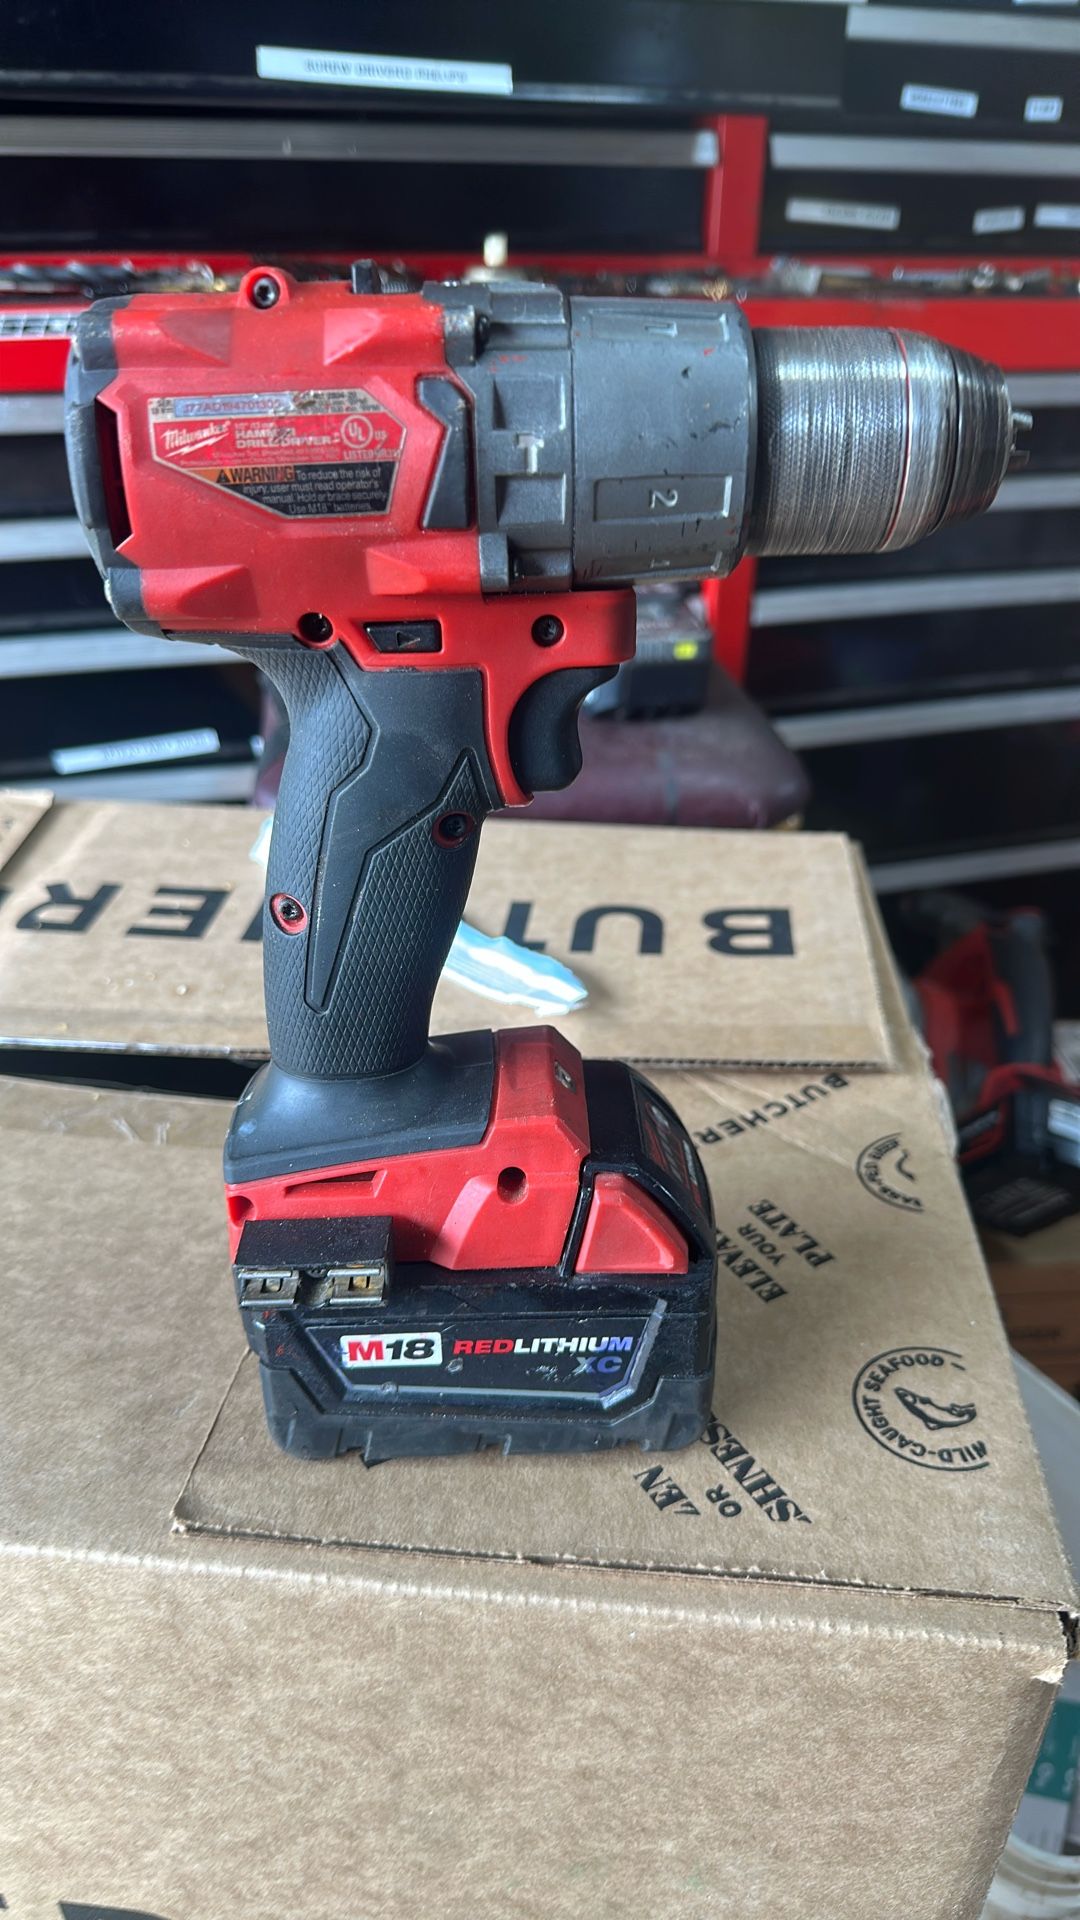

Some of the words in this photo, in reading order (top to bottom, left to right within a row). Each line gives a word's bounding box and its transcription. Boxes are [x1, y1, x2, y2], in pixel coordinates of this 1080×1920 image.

[160, 422, 229, 451] Milwaukee
[235, 428, 295, 439] HAMMR
[230, 466, 294, 483] WARNING
[308, 469, 338, 480] reduce
[339, 469, 354, 479] the
[355, 468, 371, 478] risk
[372, 467, 382, 477] of
[271, 485, 290, 493] user
[291, 482, 313, 492] must
[315, 480, 334, 491] read
[298, 492, 317, 502] Hold
[328, 491, 351, 501] brace
[651, 489, 678, 509] 2
[288, 503, 307, 514] Use
[747, 1198, 836, 1269] PLATE
[737, 1222, 788, 1266] YOUR
[348, 1338, 436, 1361] M18
[453, 1336, 633, 1355] REDLITHIUM
[575, 1355, 624, 1373] XC
[863, 1353, 945, 1392] SEAFOOD
